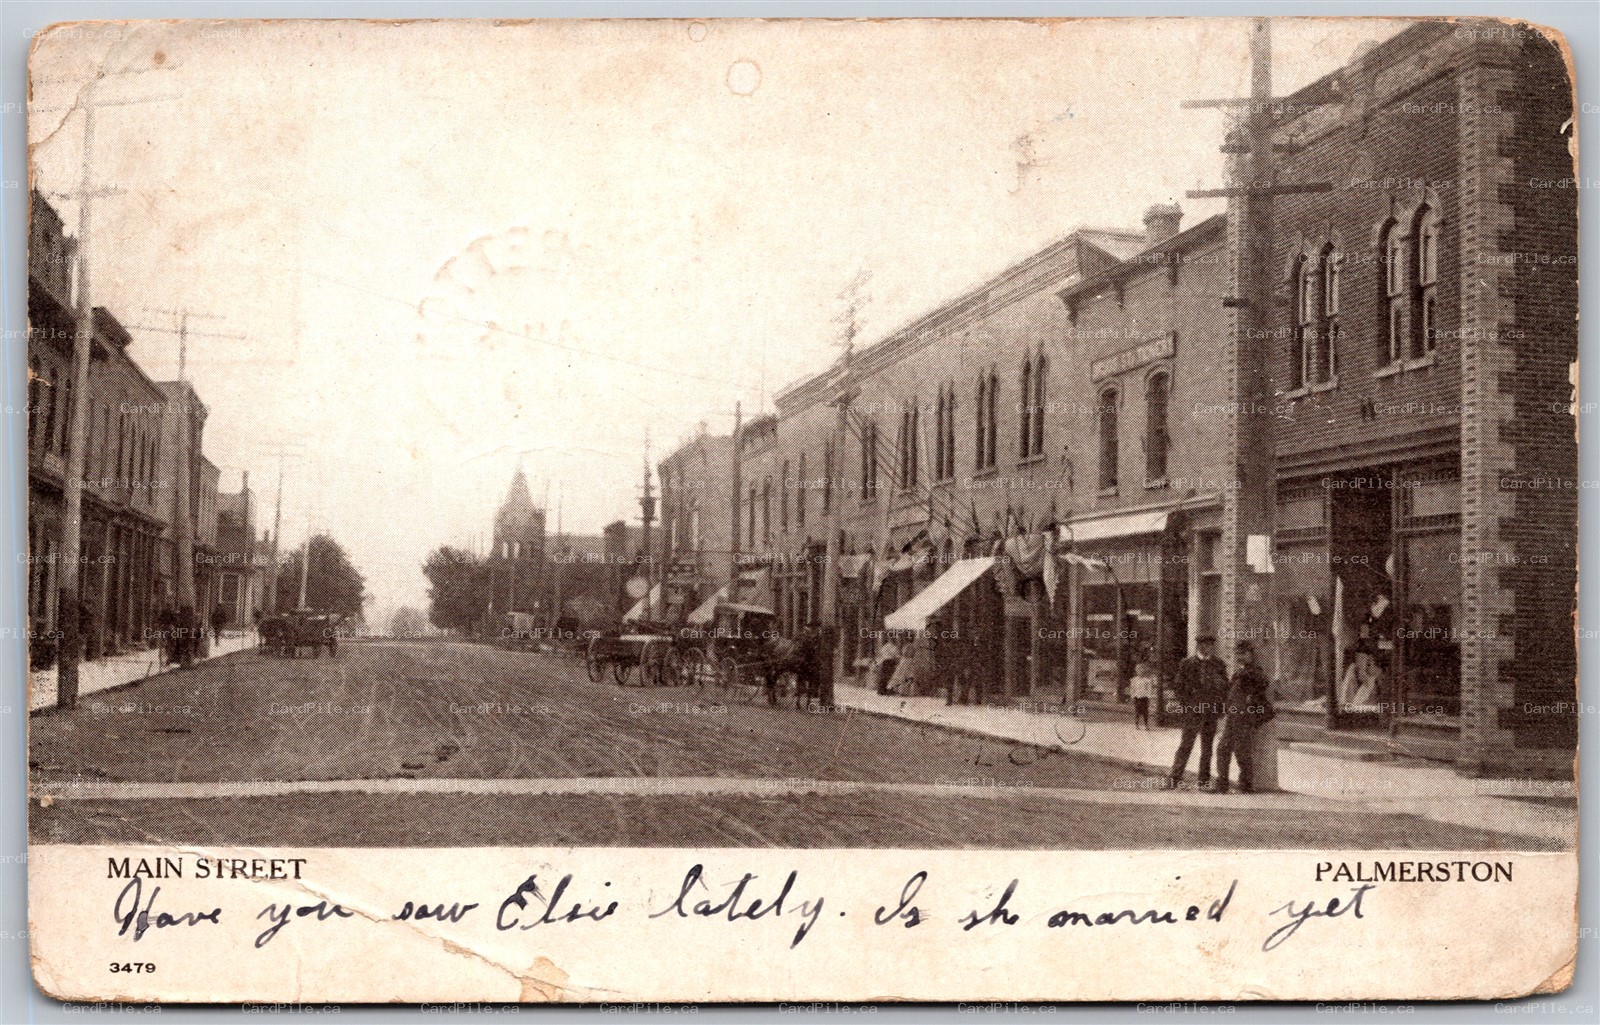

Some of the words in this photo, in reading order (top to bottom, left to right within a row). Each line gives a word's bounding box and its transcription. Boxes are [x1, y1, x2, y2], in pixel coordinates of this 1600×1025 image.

[107, 858, 183, 880] MAIN
[195, 859, 307, 880] STREET
[1315, 861, 1513, 882] PALMERSTON
[114, 878, 221, 941] Have
[255, 900, 354, 949] you
[874, 870, 928, 928] Is
[1261, 883, 1377, 953] yet
[109, 962, 156, 974] 3479
